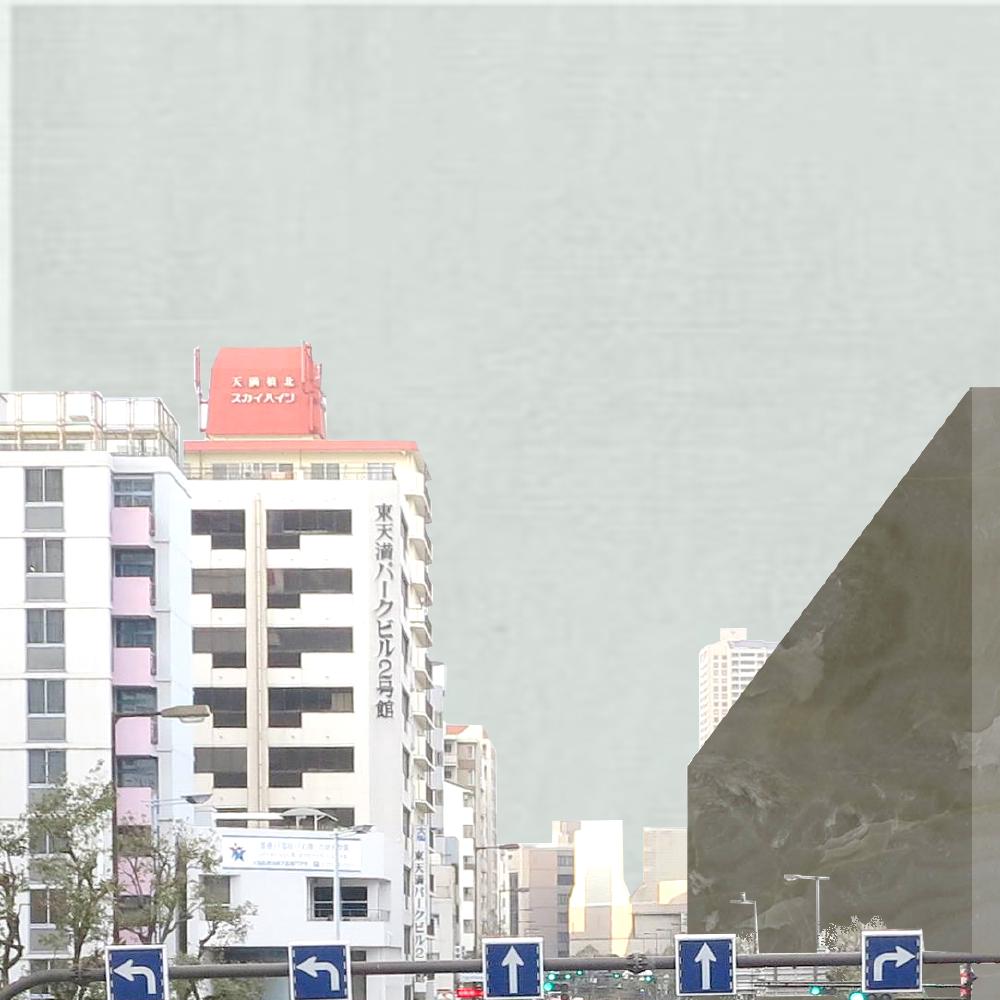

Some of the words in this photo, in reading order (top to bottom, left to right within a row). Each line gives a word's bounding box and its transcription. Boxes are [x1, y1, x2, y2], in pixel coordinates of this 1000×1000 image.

[375, 503, 394, 718] 東天満パークビル2号館
[414, 850, 425, 982] 東天満パークビル2
